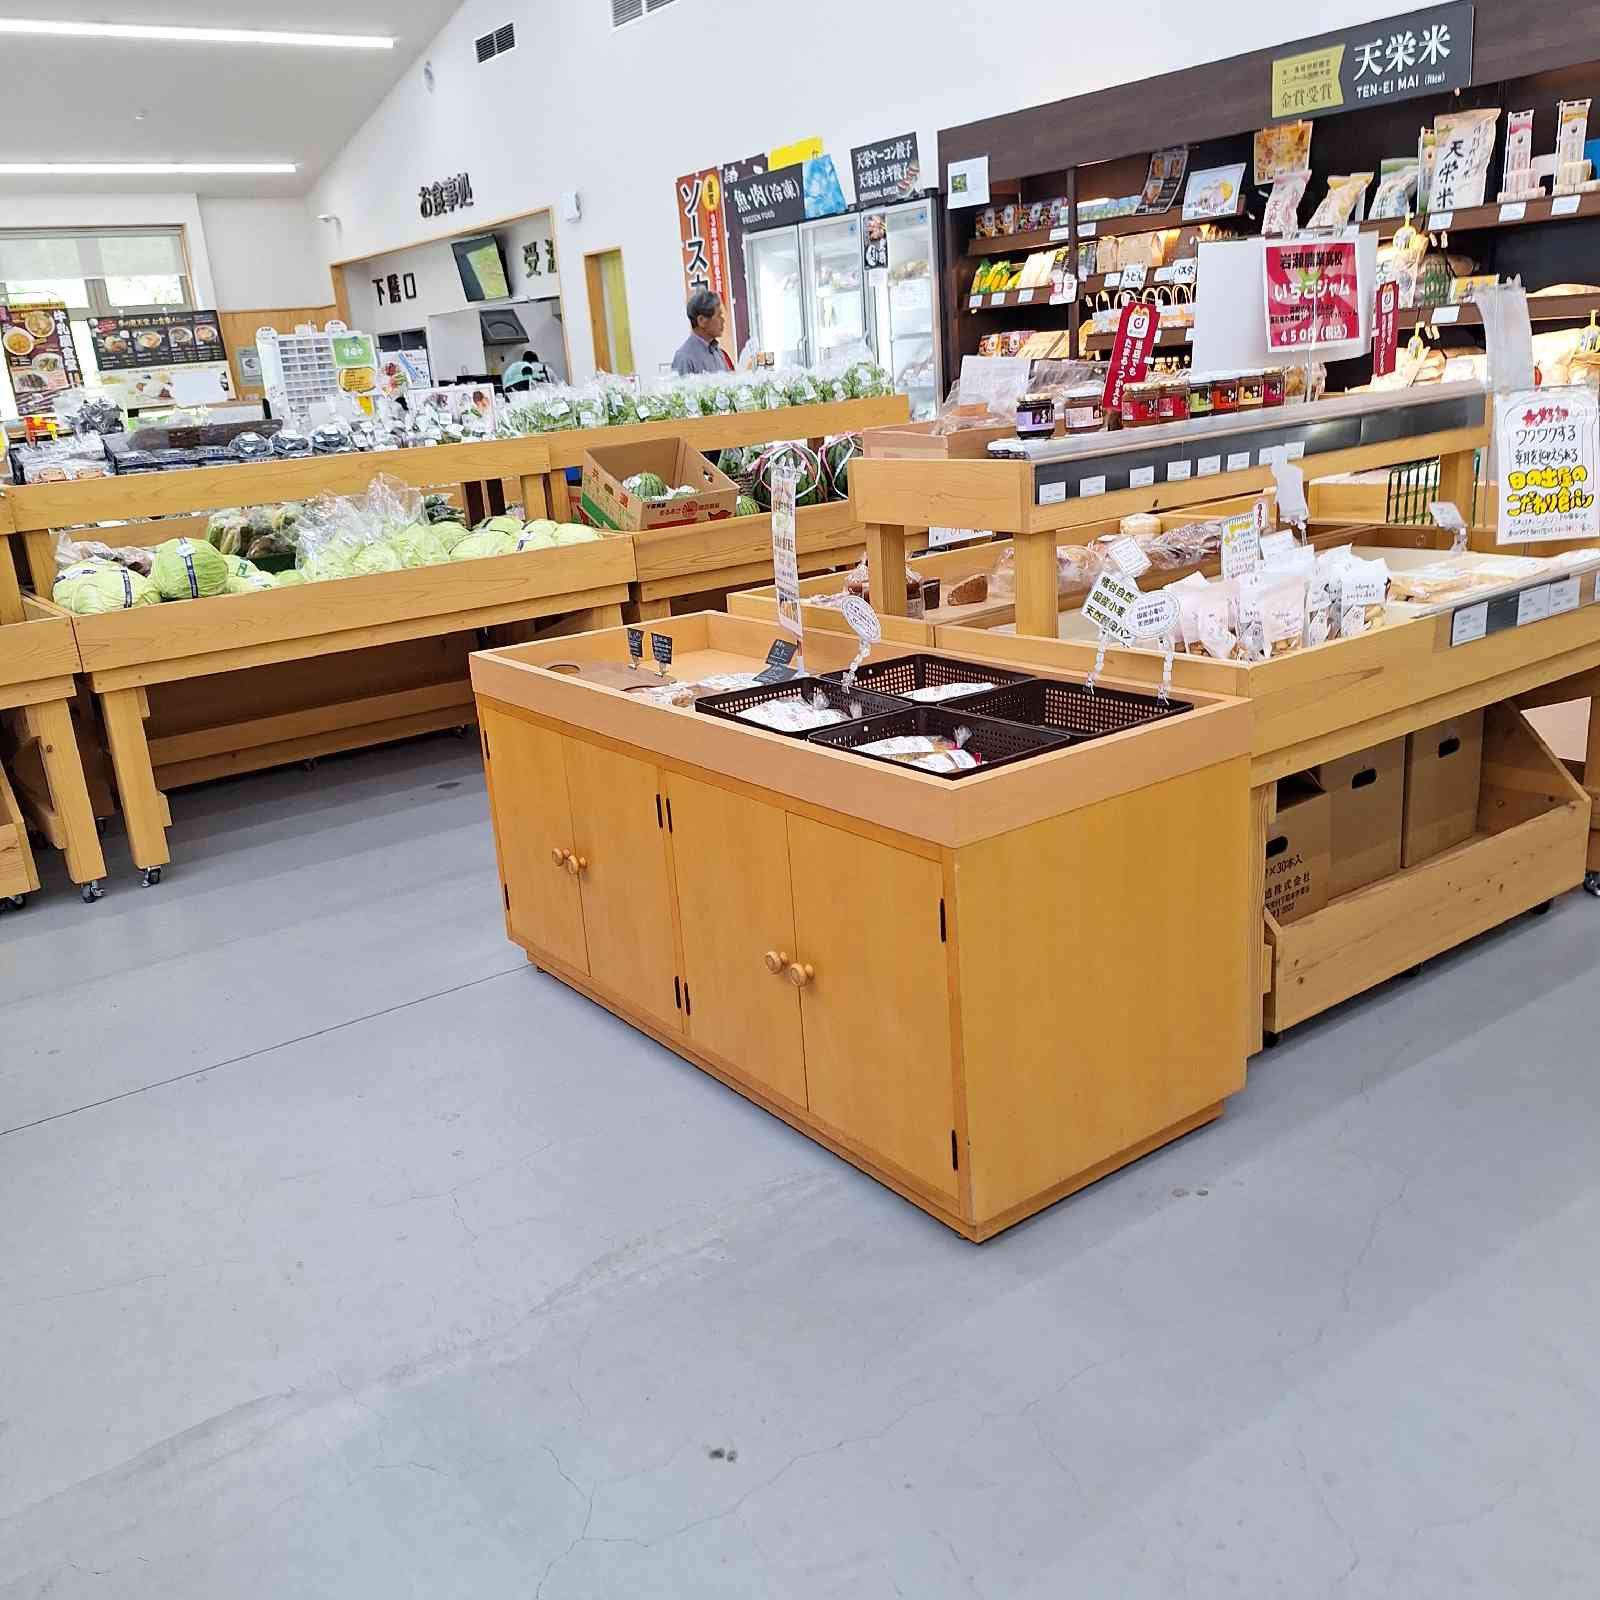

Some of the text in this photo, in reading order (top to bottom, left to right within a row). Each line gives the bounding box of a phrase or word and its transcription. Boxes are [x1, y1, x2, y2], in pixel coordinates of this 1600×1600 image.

[1353, 24, 1451, 81] 天栄米
[1356, 80, 1394, 99] TEN-EI
[1397, 75, 1419, 92] MAI
[418, 172, 474, 219] お食事処
[1274, 279, 1350, 302] いちごジャム
[1516, 425, 1576, 447] ワクワクする
